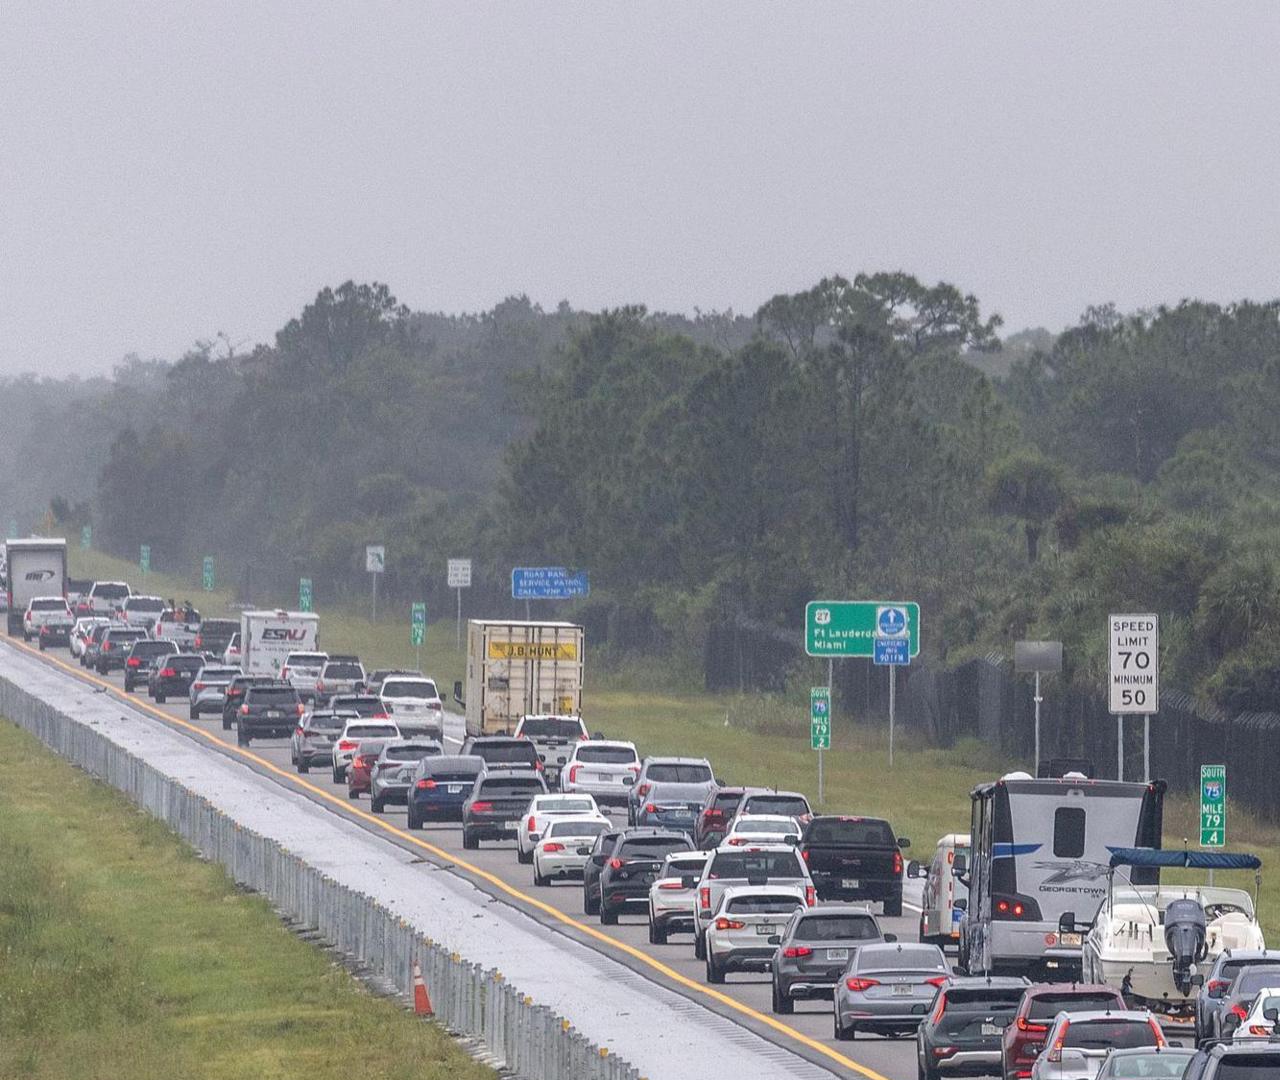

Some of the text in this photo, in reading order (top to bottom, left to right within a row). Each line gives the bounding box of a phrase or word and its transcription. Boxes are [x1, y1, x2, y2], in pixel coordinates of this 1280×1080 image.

[817, 611, 828, 620] 27
[1113, 621, 1154, 632] SPEED
[814, 629, 825, 637] Ft
[814, 641, 846, 649] Miami
[1117, 636, 1148, 647] LIMIT
[530, 647, 558, 657] HUNT
[1118, 651, 1150, 670] 70
[1114, 674, 1153, 685] MINIMUM
[1122, 689, 1146, 706] 50
[816, 725, 826, 735] 79
[1202, 767, 1225, 778] SOUTH
[1206, 786, 1220, 798] 75
[1202, 803, 1223, 814] MILE
[1205, 814, 1221, 827] 79
[1207, 831, 1218, 844] .4
[1039, 885, 1106, 894] GEORGETOWN
